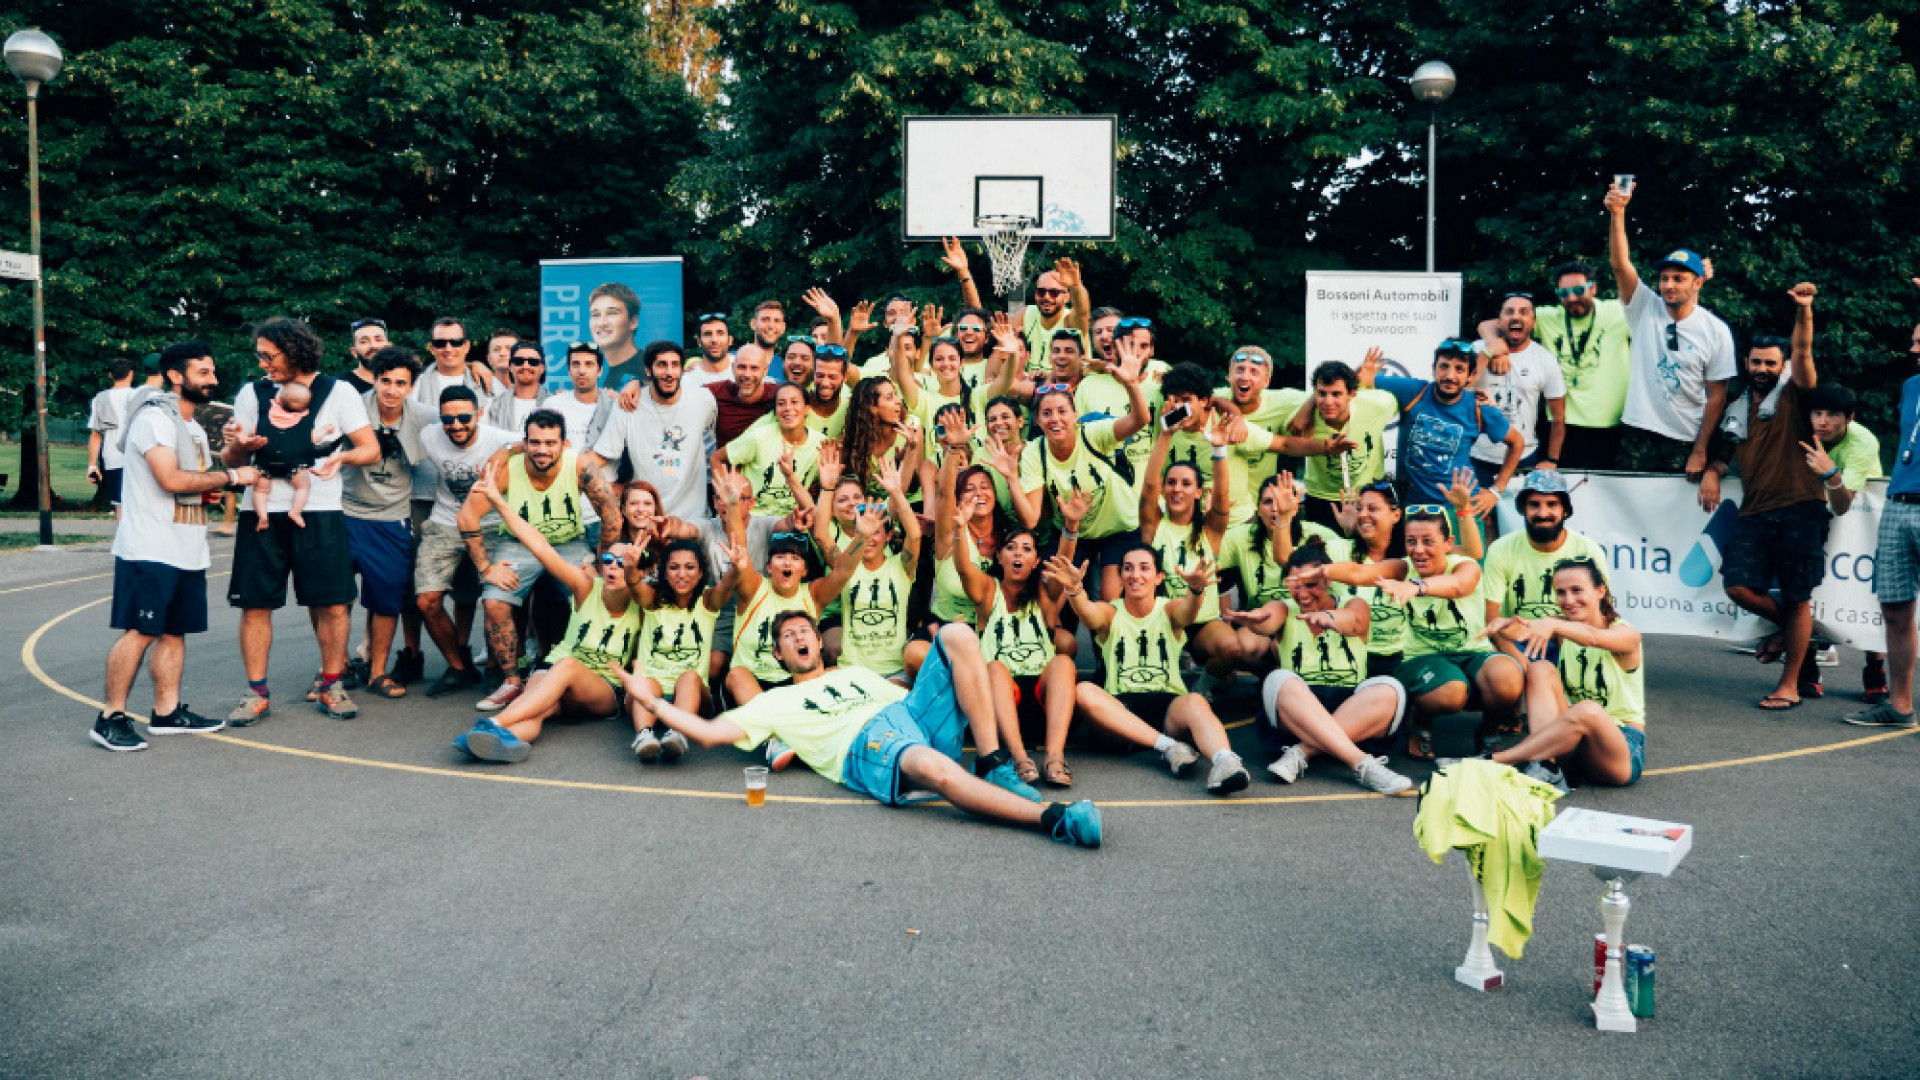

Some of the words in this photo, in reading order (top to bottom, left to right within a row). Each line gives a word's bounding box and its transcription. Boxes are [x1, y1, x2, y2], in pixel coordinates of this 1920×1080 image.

[1317, 289, 1370, 300] Bossoni
[1373, 289, 1449, 302] Automobili
[1331, 311, 1339, 320] ti
[1342, 311, 1387, 322] aspetta
[1391, 311, 1410, 320] nei
[1413, 311, 1437, 321] suoi
[1351, 323, 1417, 335] Showroom
[1626, 591, 1694, 613] buona
[1835, 607, 1883, 627] casa
